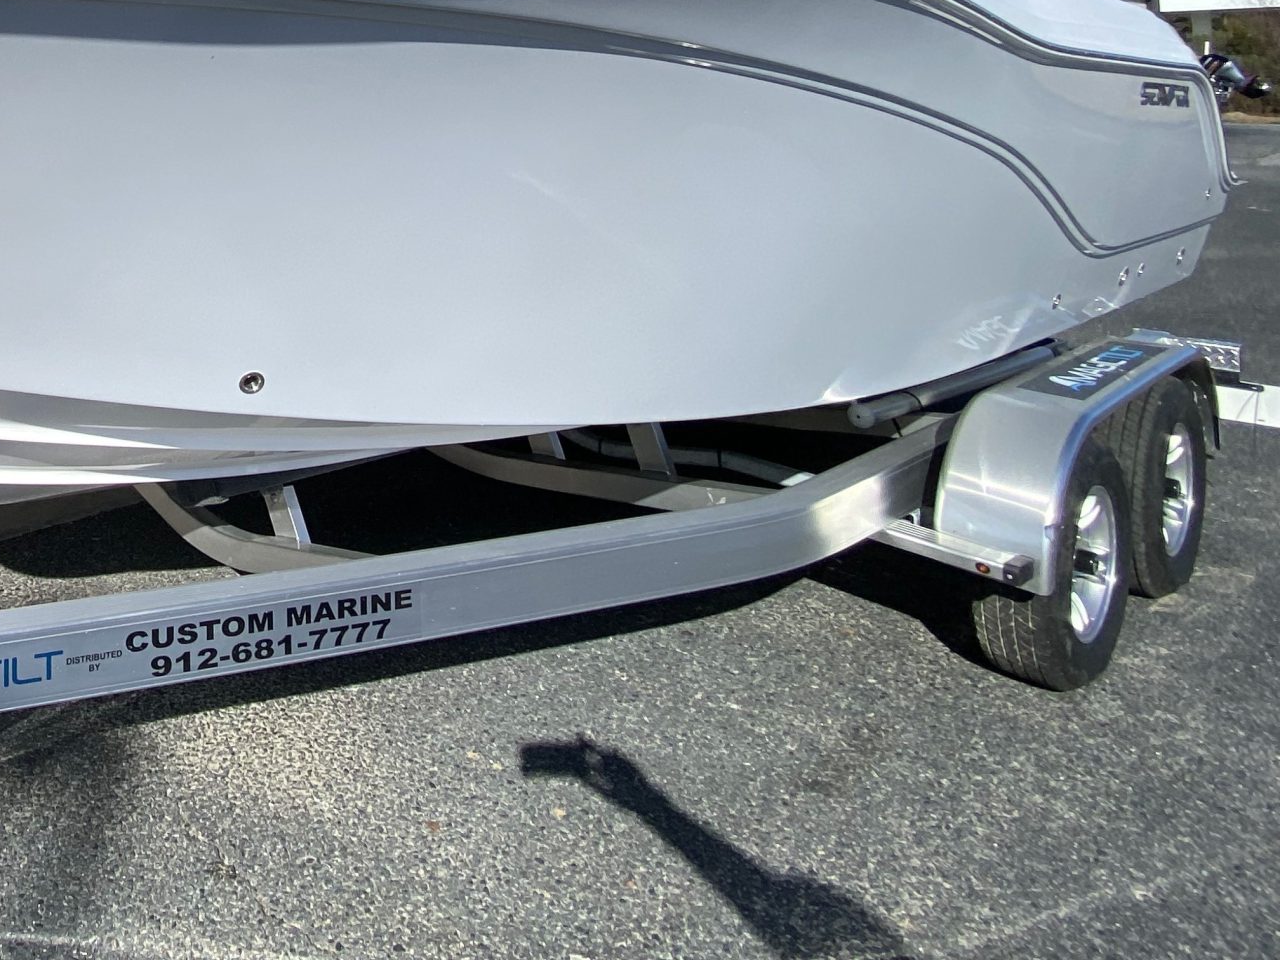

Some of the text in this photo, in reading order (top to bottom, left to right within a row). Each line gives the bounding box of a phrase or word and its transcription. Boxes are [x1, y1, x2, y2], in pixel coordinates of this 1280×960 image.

[125, 589, 413, 653] CUSTOM MARINE
[66, 650, 123, 666] DISTRIBUTED
[150, 619, 391, 677] 912-681-7777
[88, 663, 101, 673] BY
